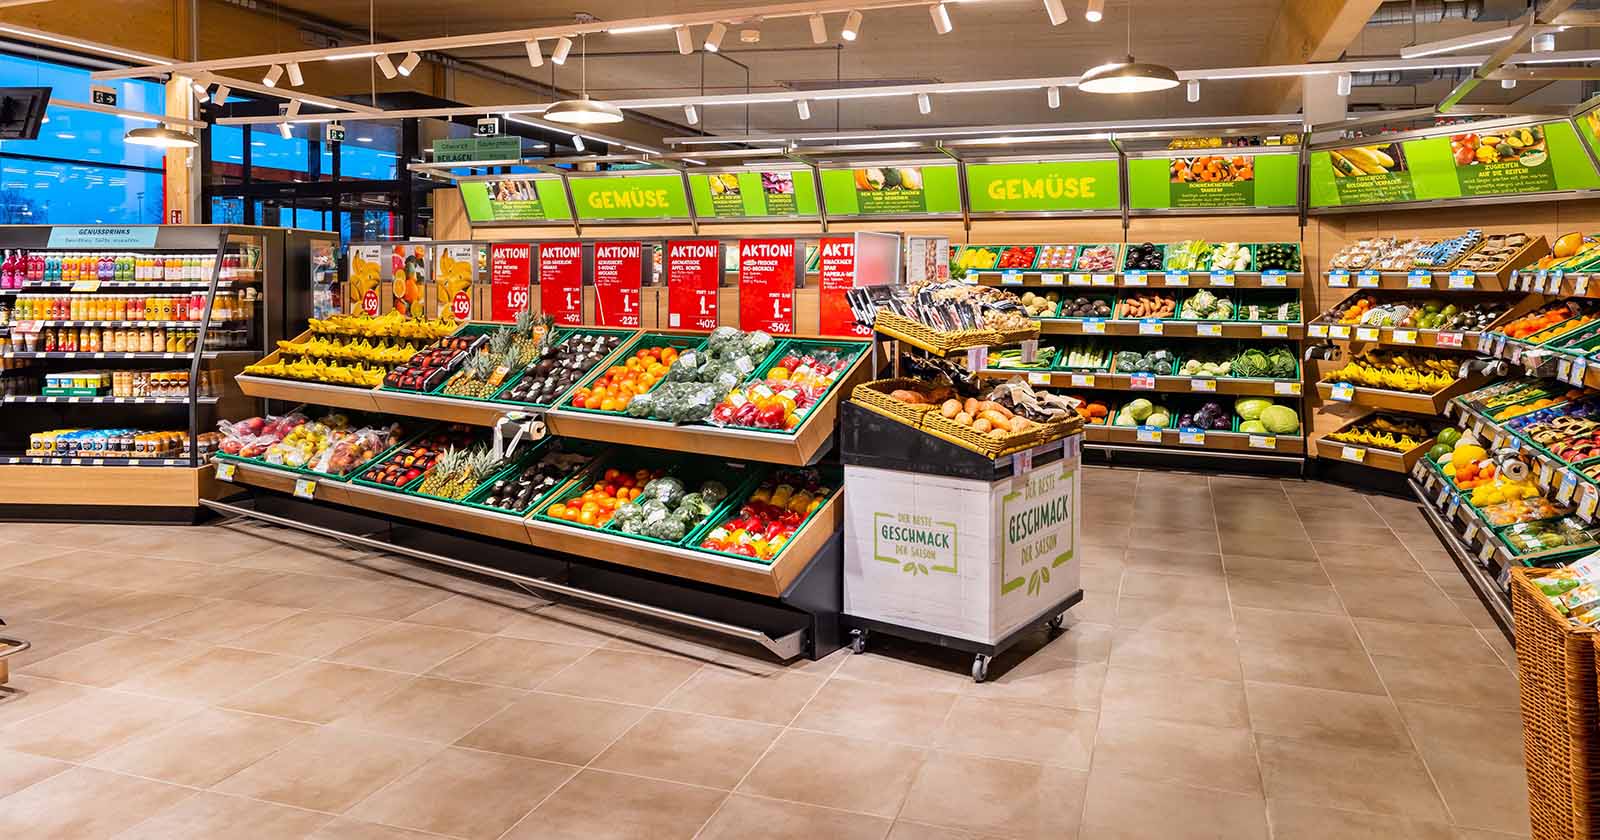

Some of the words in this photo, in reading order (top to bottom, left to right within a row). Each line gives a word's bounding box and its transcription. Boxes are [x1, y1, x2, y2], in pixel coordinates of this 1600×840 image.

[988, 174, 1097, 201] GEMÜSE
[588, 186, 670, 210] GEMÜSE
[494, 248, 529, 258] AKTION!
[542, 247, 580, 258] AKTION!
[597, 246, 640, 258] AKTION!
[671, 246, 717, 258] AKTION!
[742, 244, 792, 257] AKTION!
[564, 314, 580, 322] -49%
[619, 316, 638, 325] -22%
[696, 320, 716, 328] -40%
[768, 323, 790, 333] -59%
[898, 512, 911, 523] DER
[912, 514, 933, 526] BESTE
[1009, 494, 1069, 545] GESCHMACK
[881, 524, 950, 549] GESCHMACK
[895, 544, 910, 557] DER
[911, 546, 936, 560] SAISON
[1020, 548, 1034, 566] DER
[1035, 534, 1057, 558] SAISON
